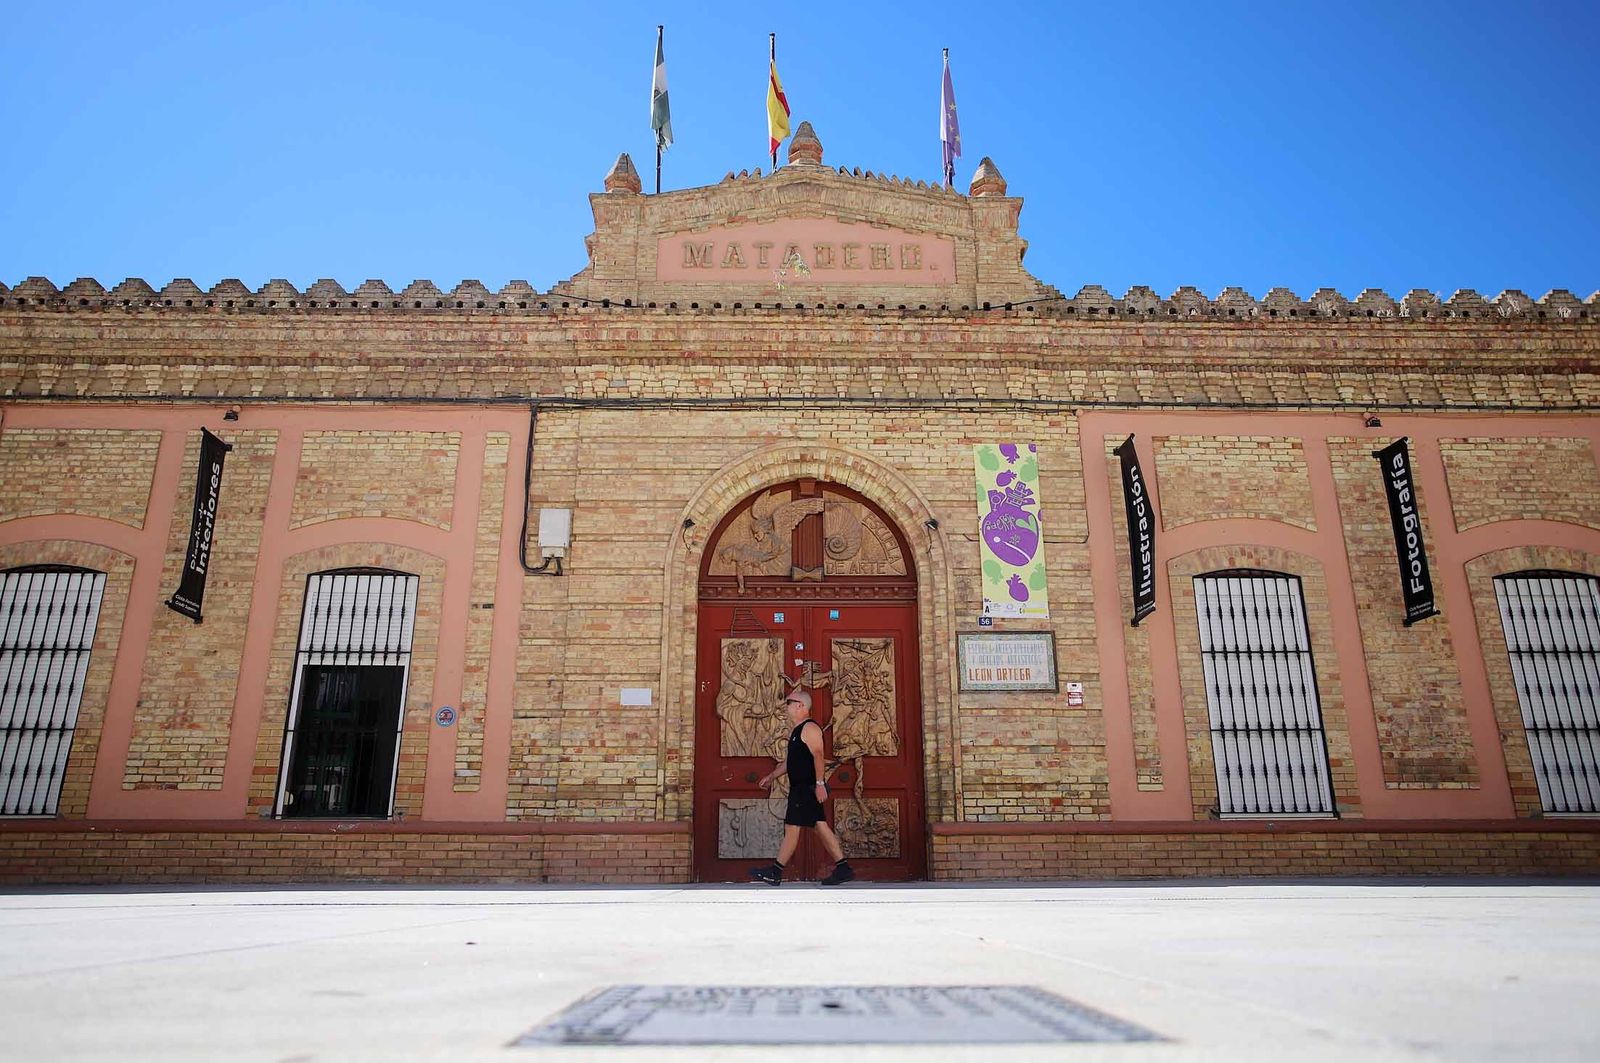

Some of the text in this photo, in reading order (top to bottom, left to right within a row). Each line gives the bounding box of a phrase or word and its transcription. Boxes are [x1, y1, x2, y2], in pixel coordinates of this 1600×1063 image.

[682, 242, 923, 270] MATADERO
[195, 462, 220, 575] Interiores
[1130, 465, 1151, 597] Ilustración
[1391, 452, 1425, 594] Fotografía
[825, 561, 887, 574] DE ARTE
[996, 667, 1031, 681] ORTEGA
